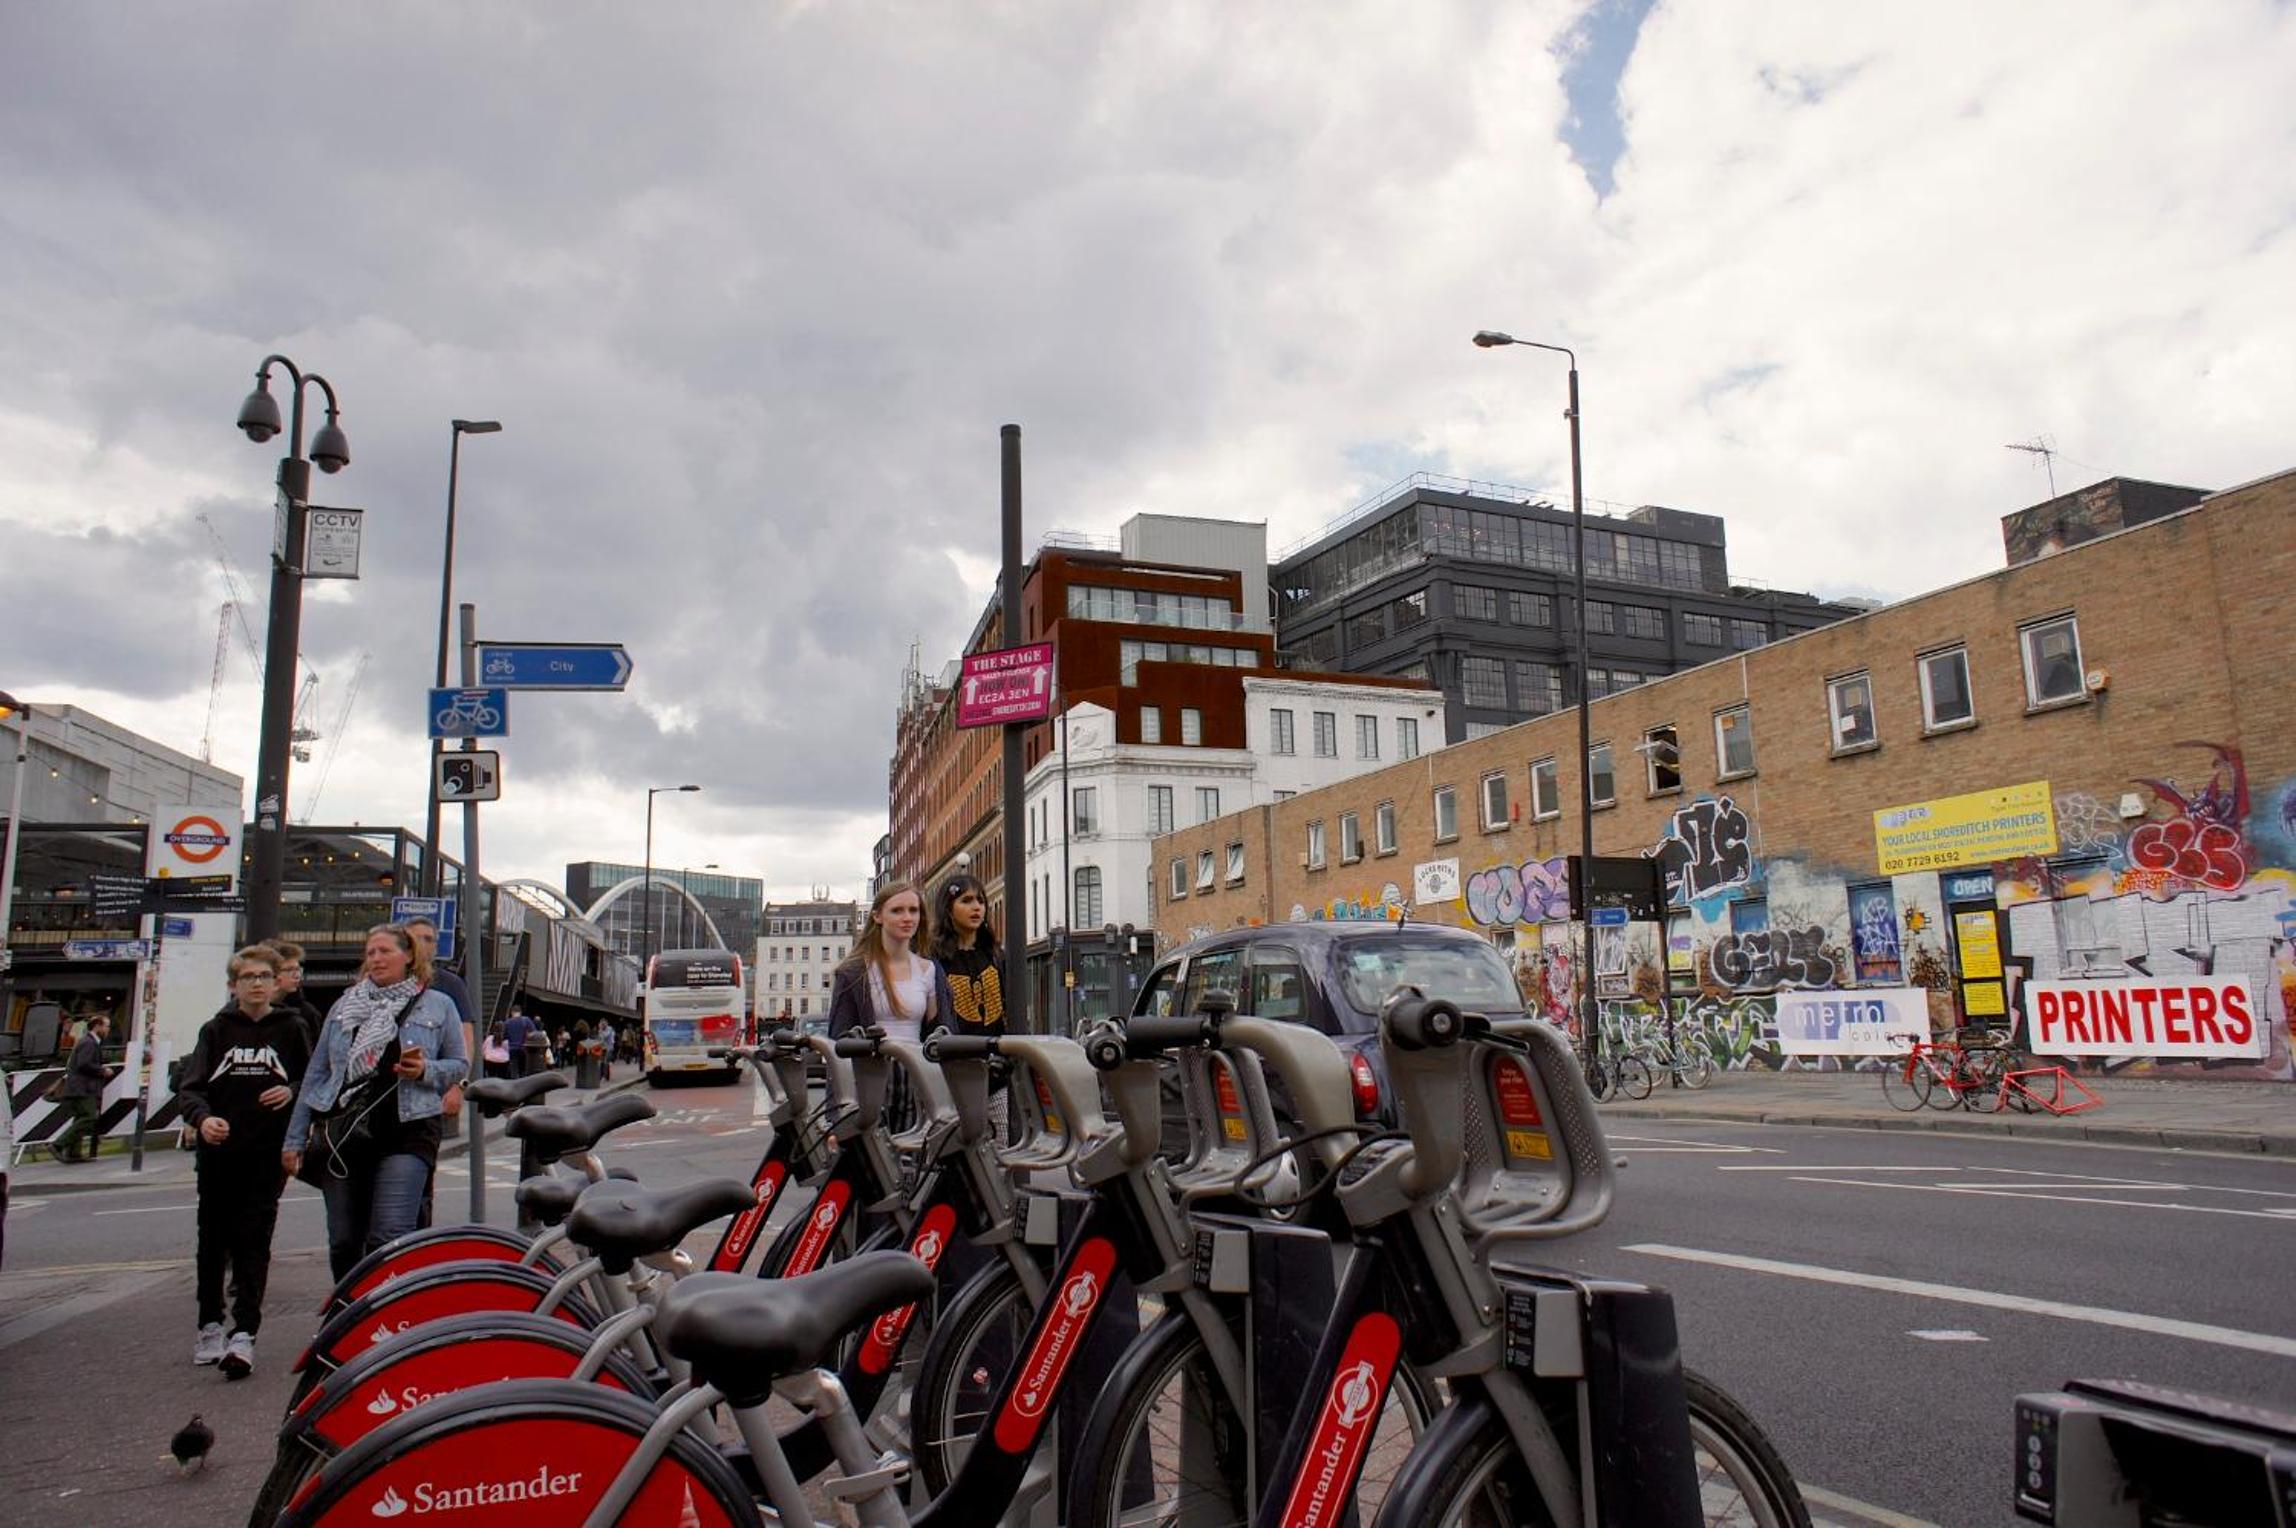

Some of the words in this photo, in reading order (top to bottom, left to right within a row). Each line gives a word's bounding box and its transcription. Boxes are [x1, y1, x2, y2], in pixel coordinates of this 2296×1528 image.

[314, 514, 358, 527] CCTV
[551, 661, 574, 673] City
[972, 657, 997, 671] THE
[1001, 650, 1042, 667] STAGE
[979, 691, 1005, 704] EC2A
[168, 834, 226, 845] OVERGROUND
[1882, 833, 1904, 847] YOUR
[1905, 829, 1930, 844] LOCAL
[1932, 820, 1990, 839] SHOREDITCH
[1993, 812, 2046, 830] PRINTERS
[1885, 859, 1903, 870] 020
[1954, 876, 1993, 895] OPEN
[1794, 1004, 1881, 1027] metro
[2037, 985, 2253, 1045] PRINTERS
[1029, 1319, 1072, 1391] Santander
[414, 1465, 582, 1513] Santander
